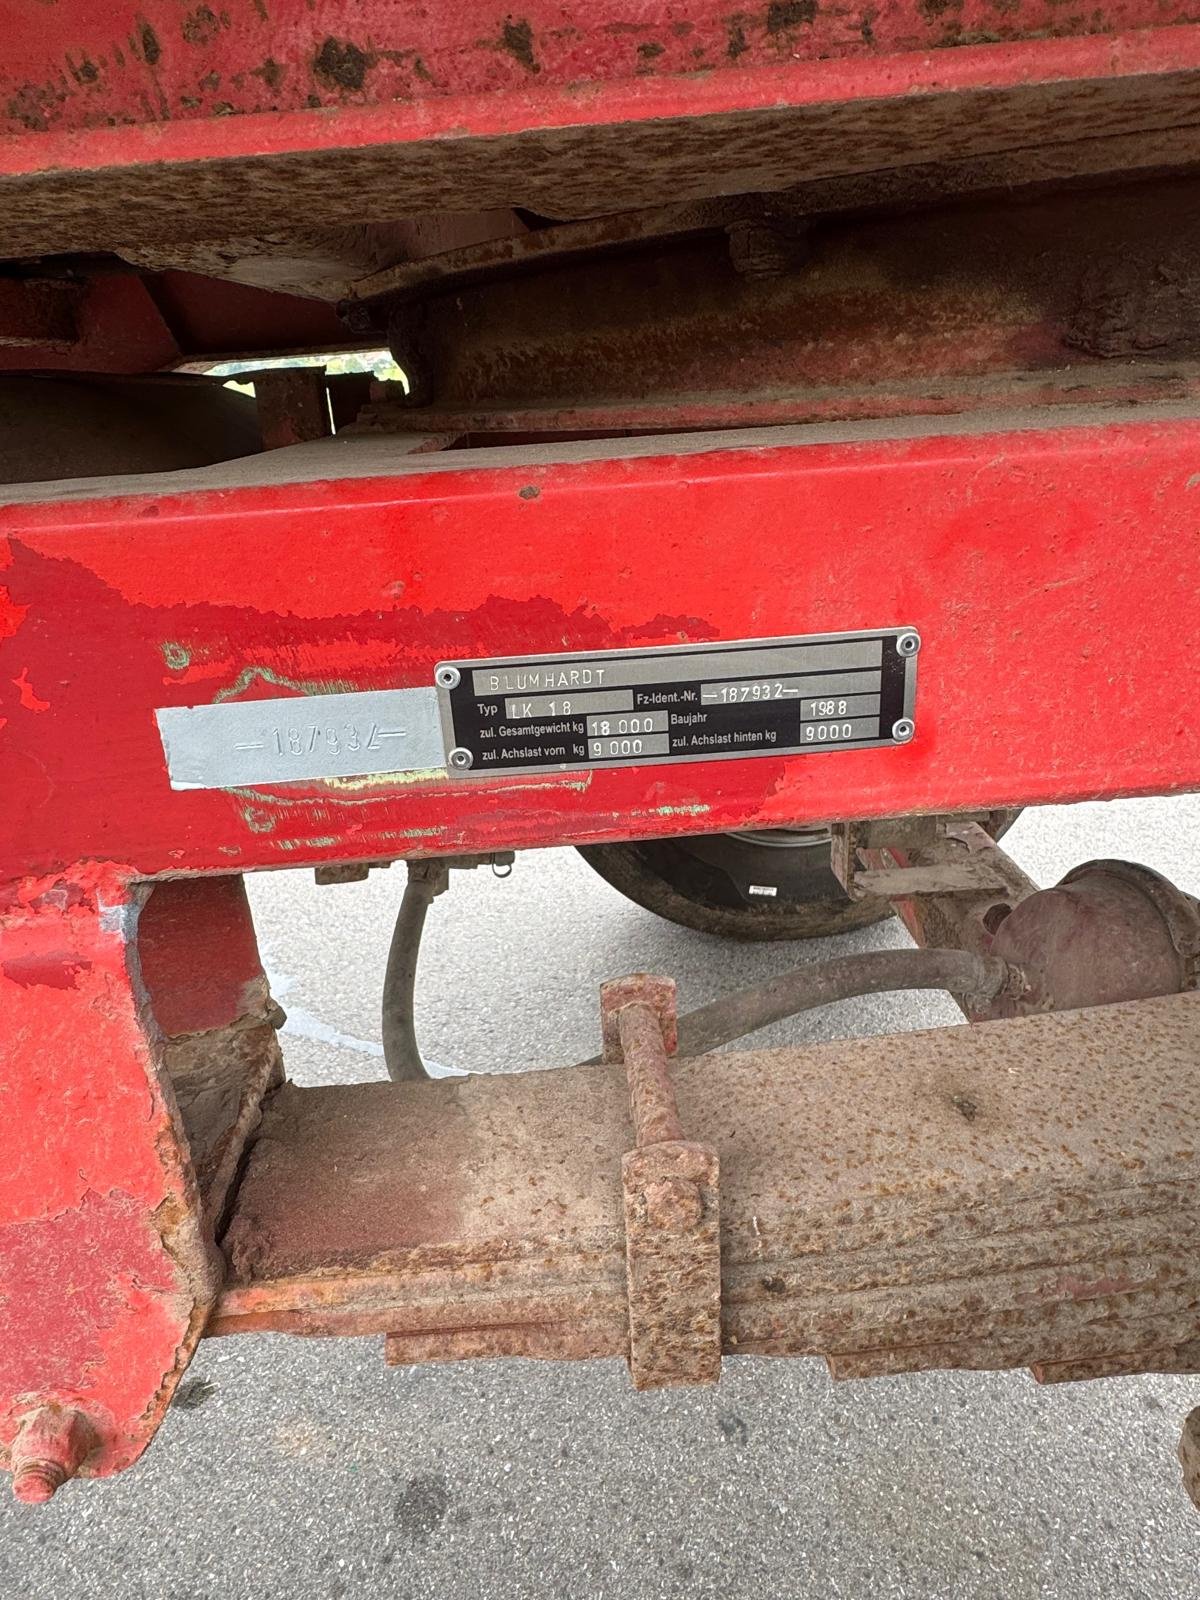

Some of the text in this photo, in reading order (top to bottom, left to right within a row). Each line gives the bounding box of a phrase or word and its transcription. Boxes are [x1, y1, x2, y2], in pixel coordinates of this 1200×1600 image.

[490, 669, 605, 691] BLUMHARDT
[637, 691, 698, 706] Fz-Ident.-Nr.
[810, 700, 847, 716] 1988
[477, 701, 572, 719] Typ LK 18
[670, 713, 708, 726] Baujahr
[480, 718, 654, 739] zul. Gesamtgewicht kg 18 000
[672, 724, 852, 748] zul. Achslast hinten kg 9000
[482, 740, 643, 761] zul. Achslast vorn kg 9 000
